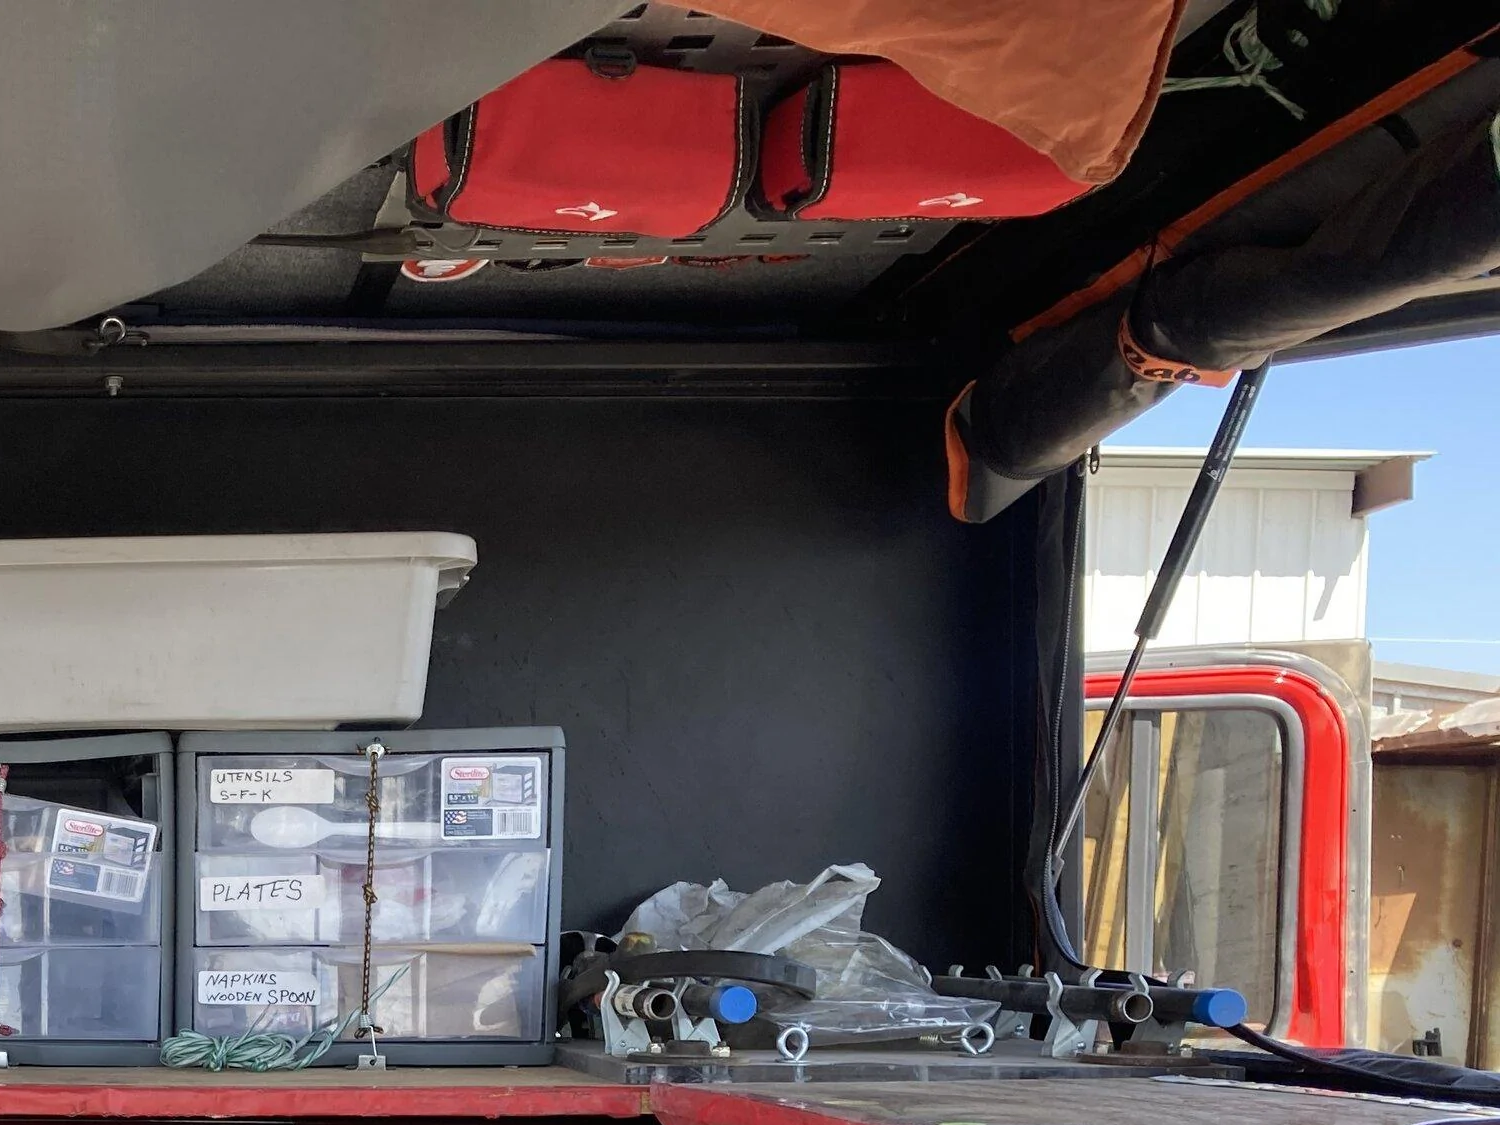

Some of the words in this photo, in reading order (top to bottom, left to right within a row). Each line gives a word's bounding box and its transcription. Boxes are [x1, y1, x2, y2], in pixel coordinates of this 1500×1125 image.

[216, 769, 293, 784] UTENSILS
[212, 879, 302, 903] PLATES
[205, 973, 277, 987] NAPKINS
[206, 990, 263, 1003] WOODEN
[267, 988, 316, 1004] SPOON
